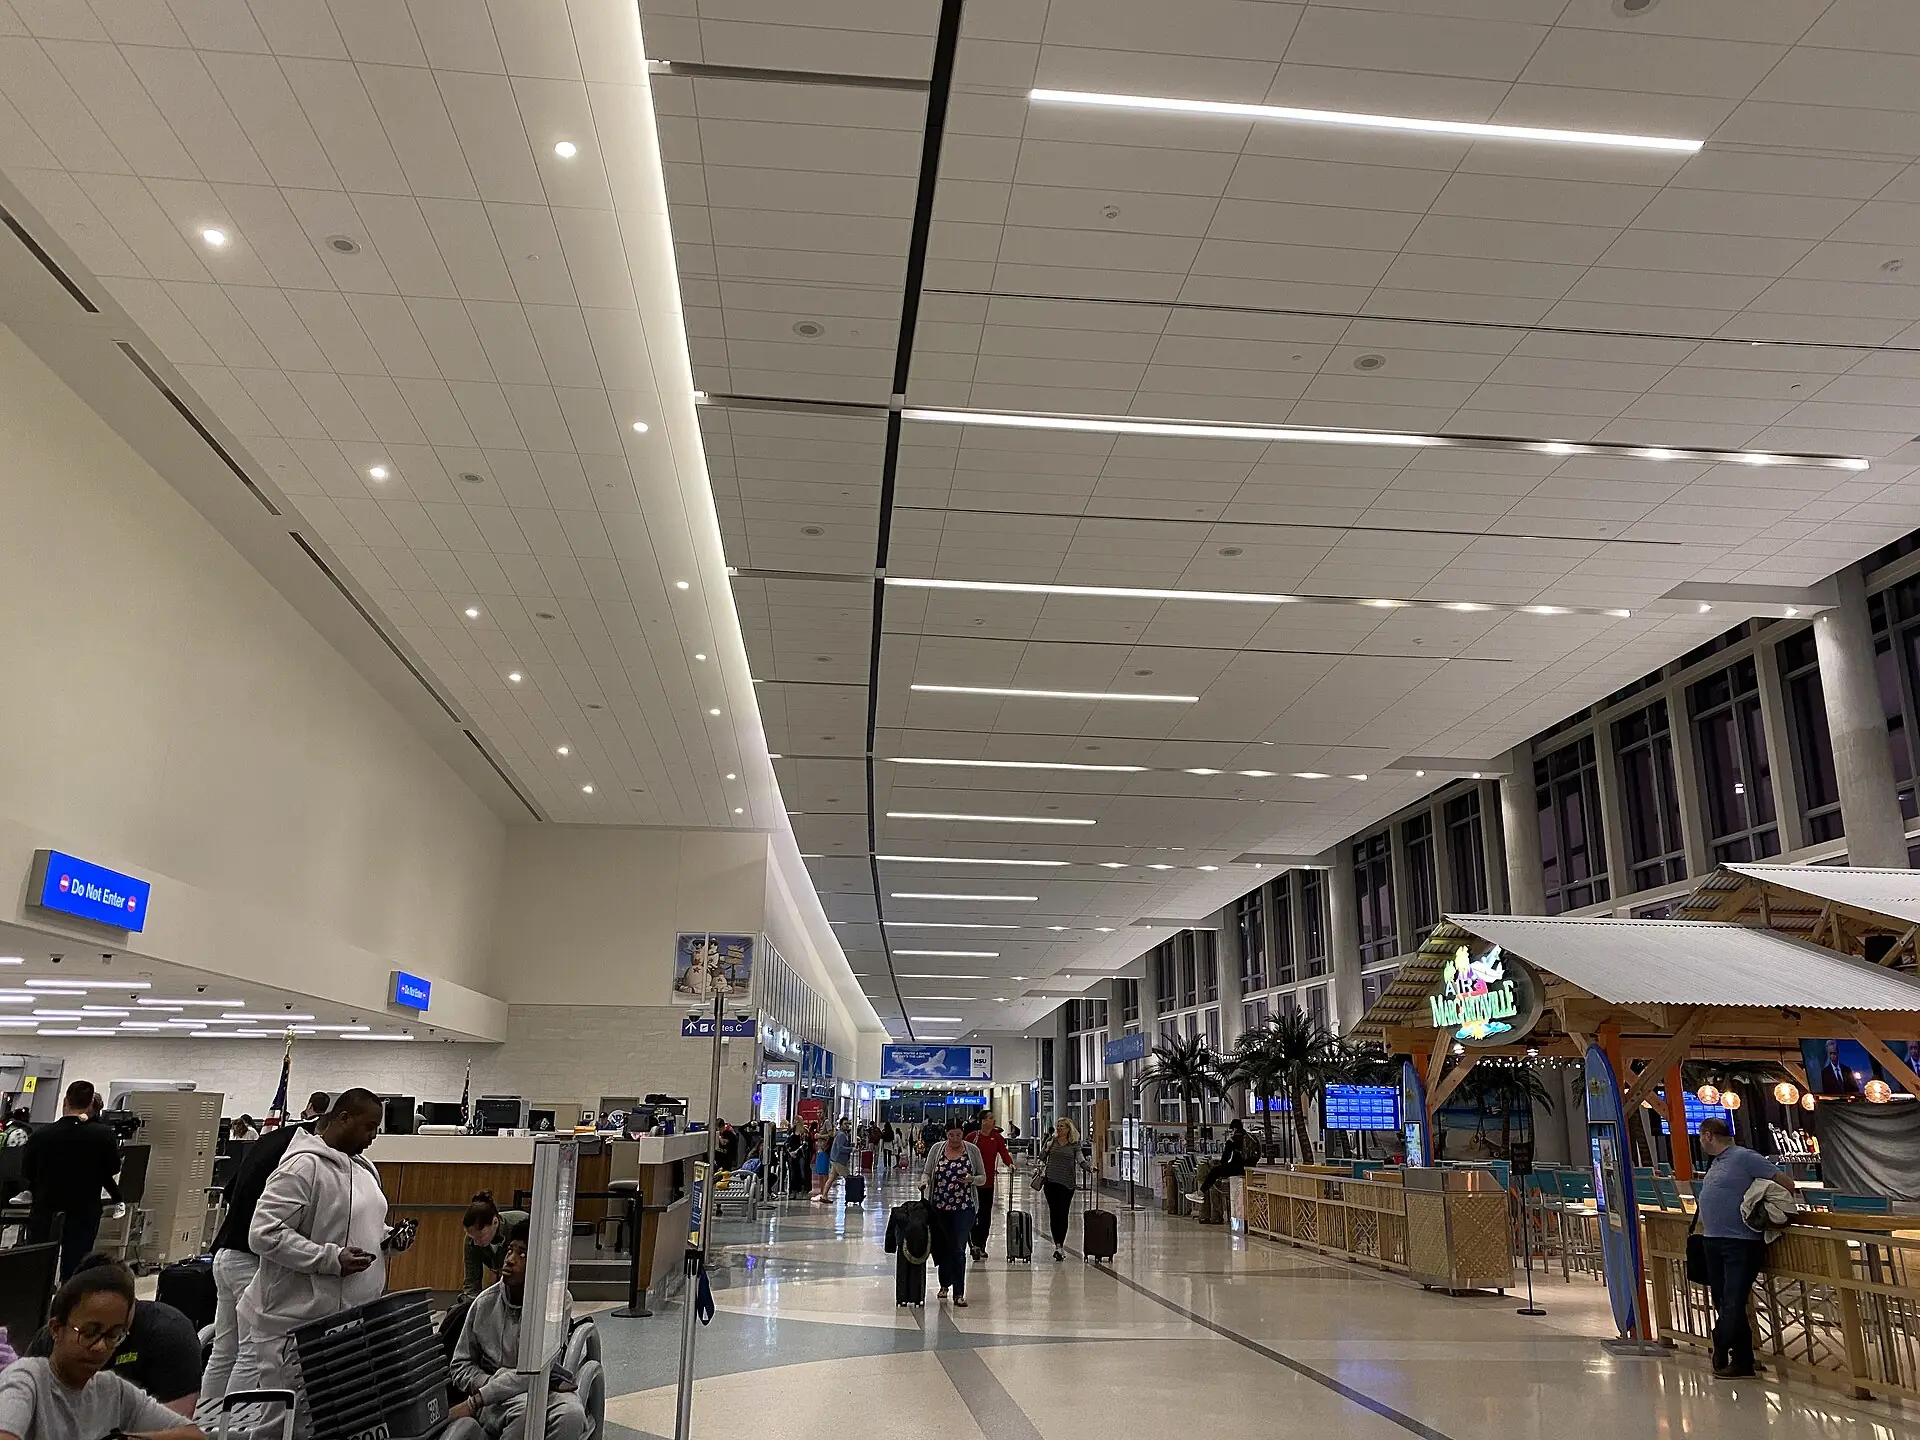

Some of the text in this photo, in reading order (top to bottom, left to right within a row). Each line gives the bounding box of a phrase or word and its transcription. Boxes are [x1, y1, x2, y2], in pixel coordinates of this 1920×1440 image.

[71, 878, 125, 908] Do Not Enter
[1445, 979, 1473, 997] AIR
[710, 1023, 743, 1032] Gtes C
[26, 1080, 33, 1089] 4
